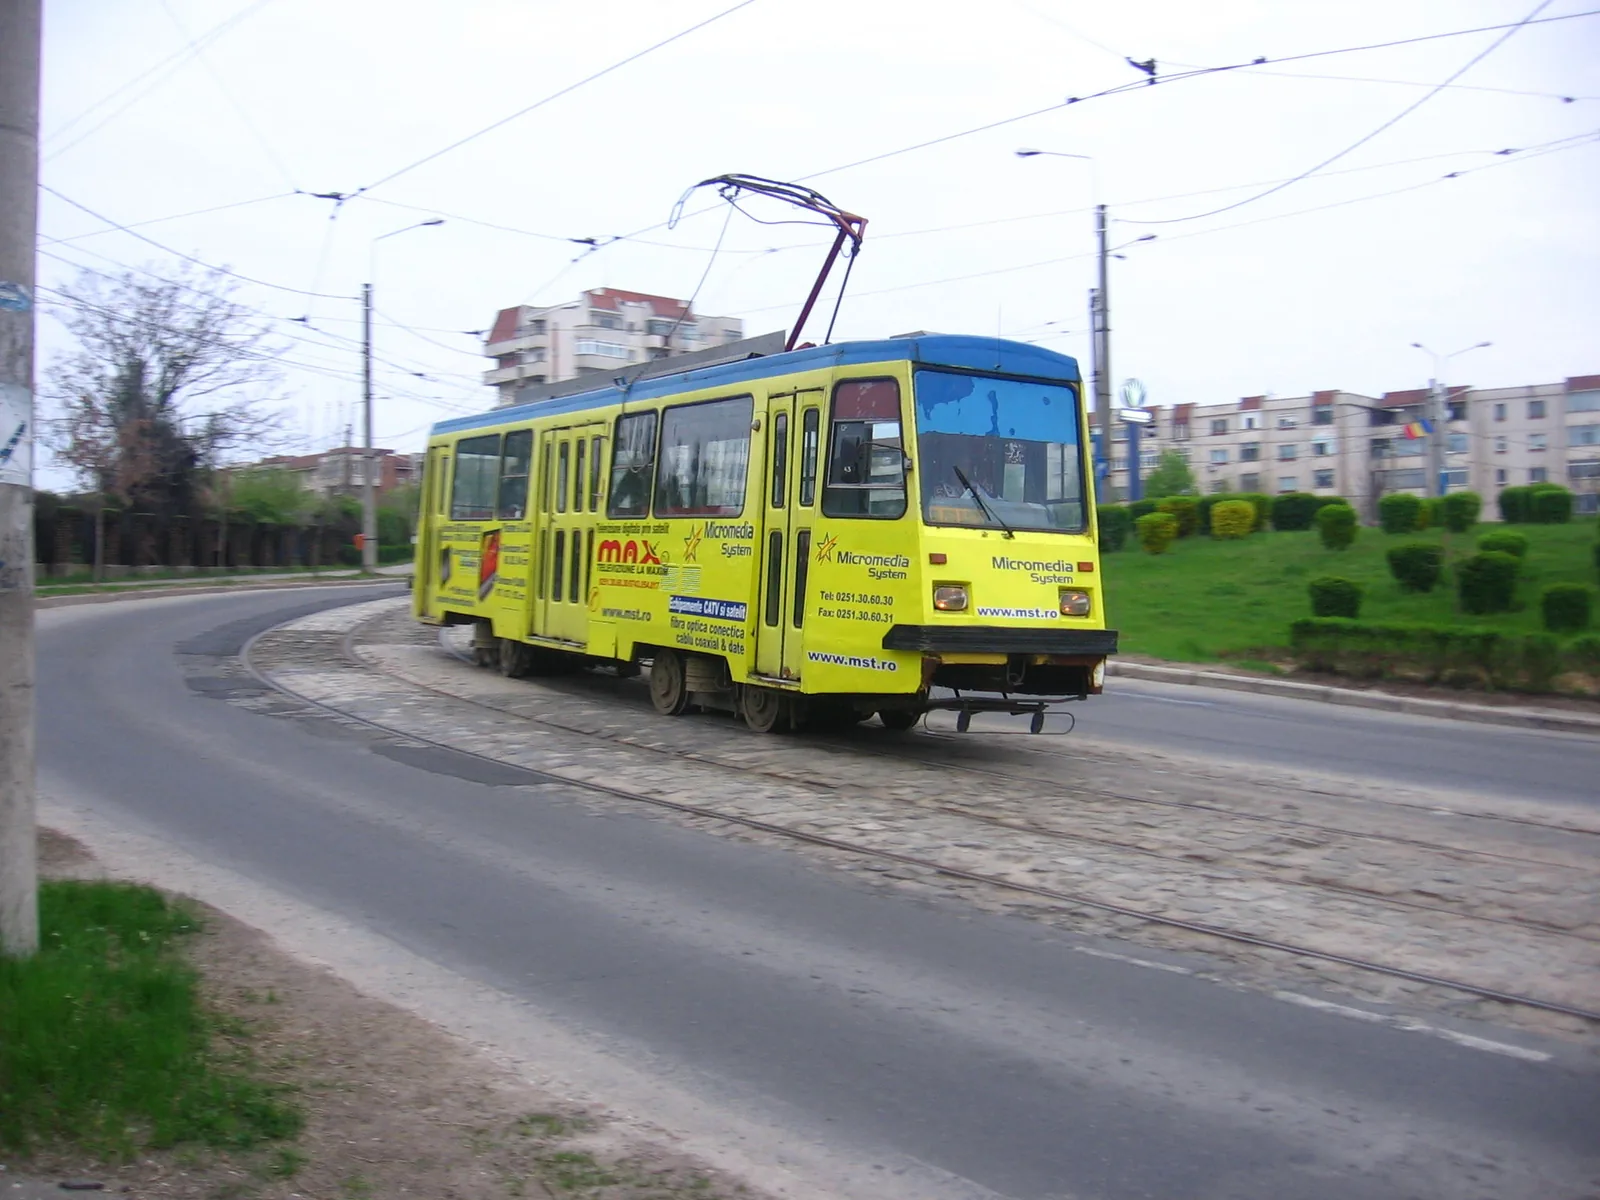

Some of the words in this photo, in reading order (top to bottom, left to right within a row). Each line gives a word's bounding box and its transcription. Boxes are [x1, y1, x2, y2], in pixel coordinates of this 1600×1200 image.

[704, 521, 754, 540] Micromedia
[721, 543, 752, 559] System
[837, 551, 910, 568] Micromedia
[992, 556, 1074, 573] Micromedia
[868, 568, 907, 580] System
[1030, 573, 1073, 585] System
[820, 591, 834, 601] Tel:
[836, 592, 893, 606] 0251.30.60.30
[602, 608, 651, 622] www.mst.ro
[703, 600, 720, 617] CATV
[818, 607, 835, 618] Fax:
[836, 609, 893, 623] 0251.30.60.31
[977, 607, 1058, 619] www.mst.ro
[687, 620, 708, 633] optica
[709, 624, 745, 640] conectica
[676, 633, 694, 646] cablu
[695, 636, 719, 651] coaxial
[721, 639, 727, 652] &
[728, 641, 745, 655] date
[808, 651, 897, 672] www.mst.ro
